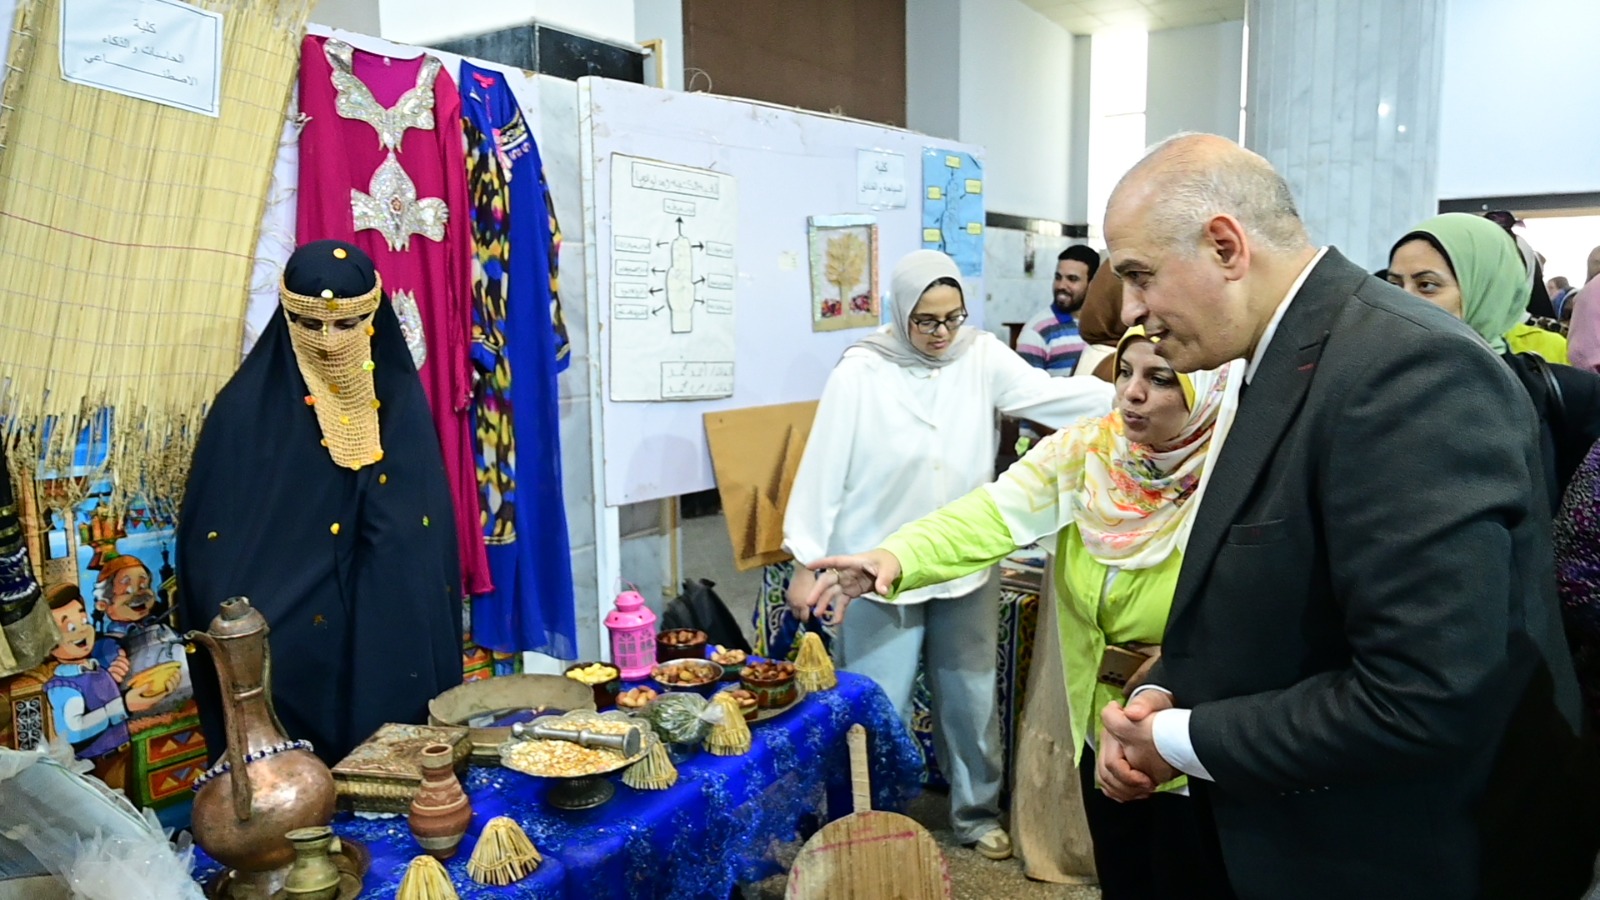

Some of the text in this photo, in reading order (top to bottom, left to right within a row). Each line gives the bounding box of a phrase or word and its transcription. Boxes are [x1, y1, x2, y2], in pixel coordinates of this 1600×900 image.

[132, 18, 157, 34] كلية
[102, 34, 130, 48] الذكاء
[140, 45, 184, 64] الحاسبات
[875, 160, 888, 174] كلية
[883, 183, 903, 195] السياحة
